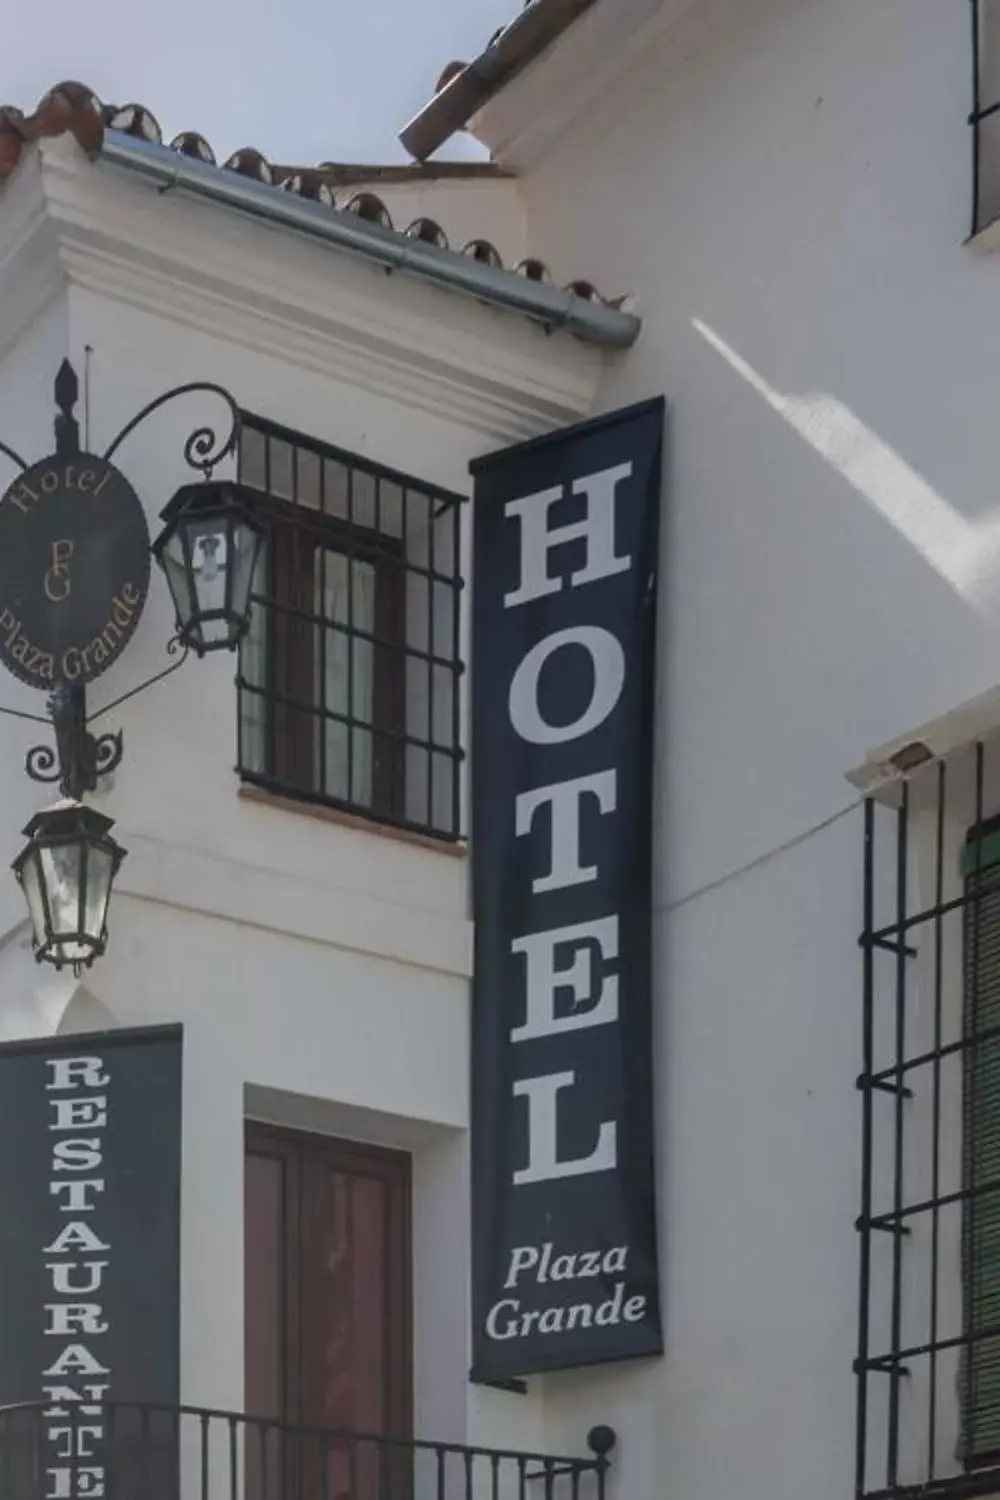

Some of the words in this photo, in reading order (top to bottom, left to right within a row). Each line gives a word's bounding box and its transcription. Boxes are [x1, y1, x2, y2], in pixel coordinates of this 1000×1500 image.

[10, 465, 113, 512] Hotel
[61, 582, 141, 680] Grande
[503, 461, 633, 1186] HOTEL
[42, 1056, 111, 1499] RESTAURANTE
[503, 1242, 629, 1289] Plaza
[485, 1281, 647, 1341] Grande
